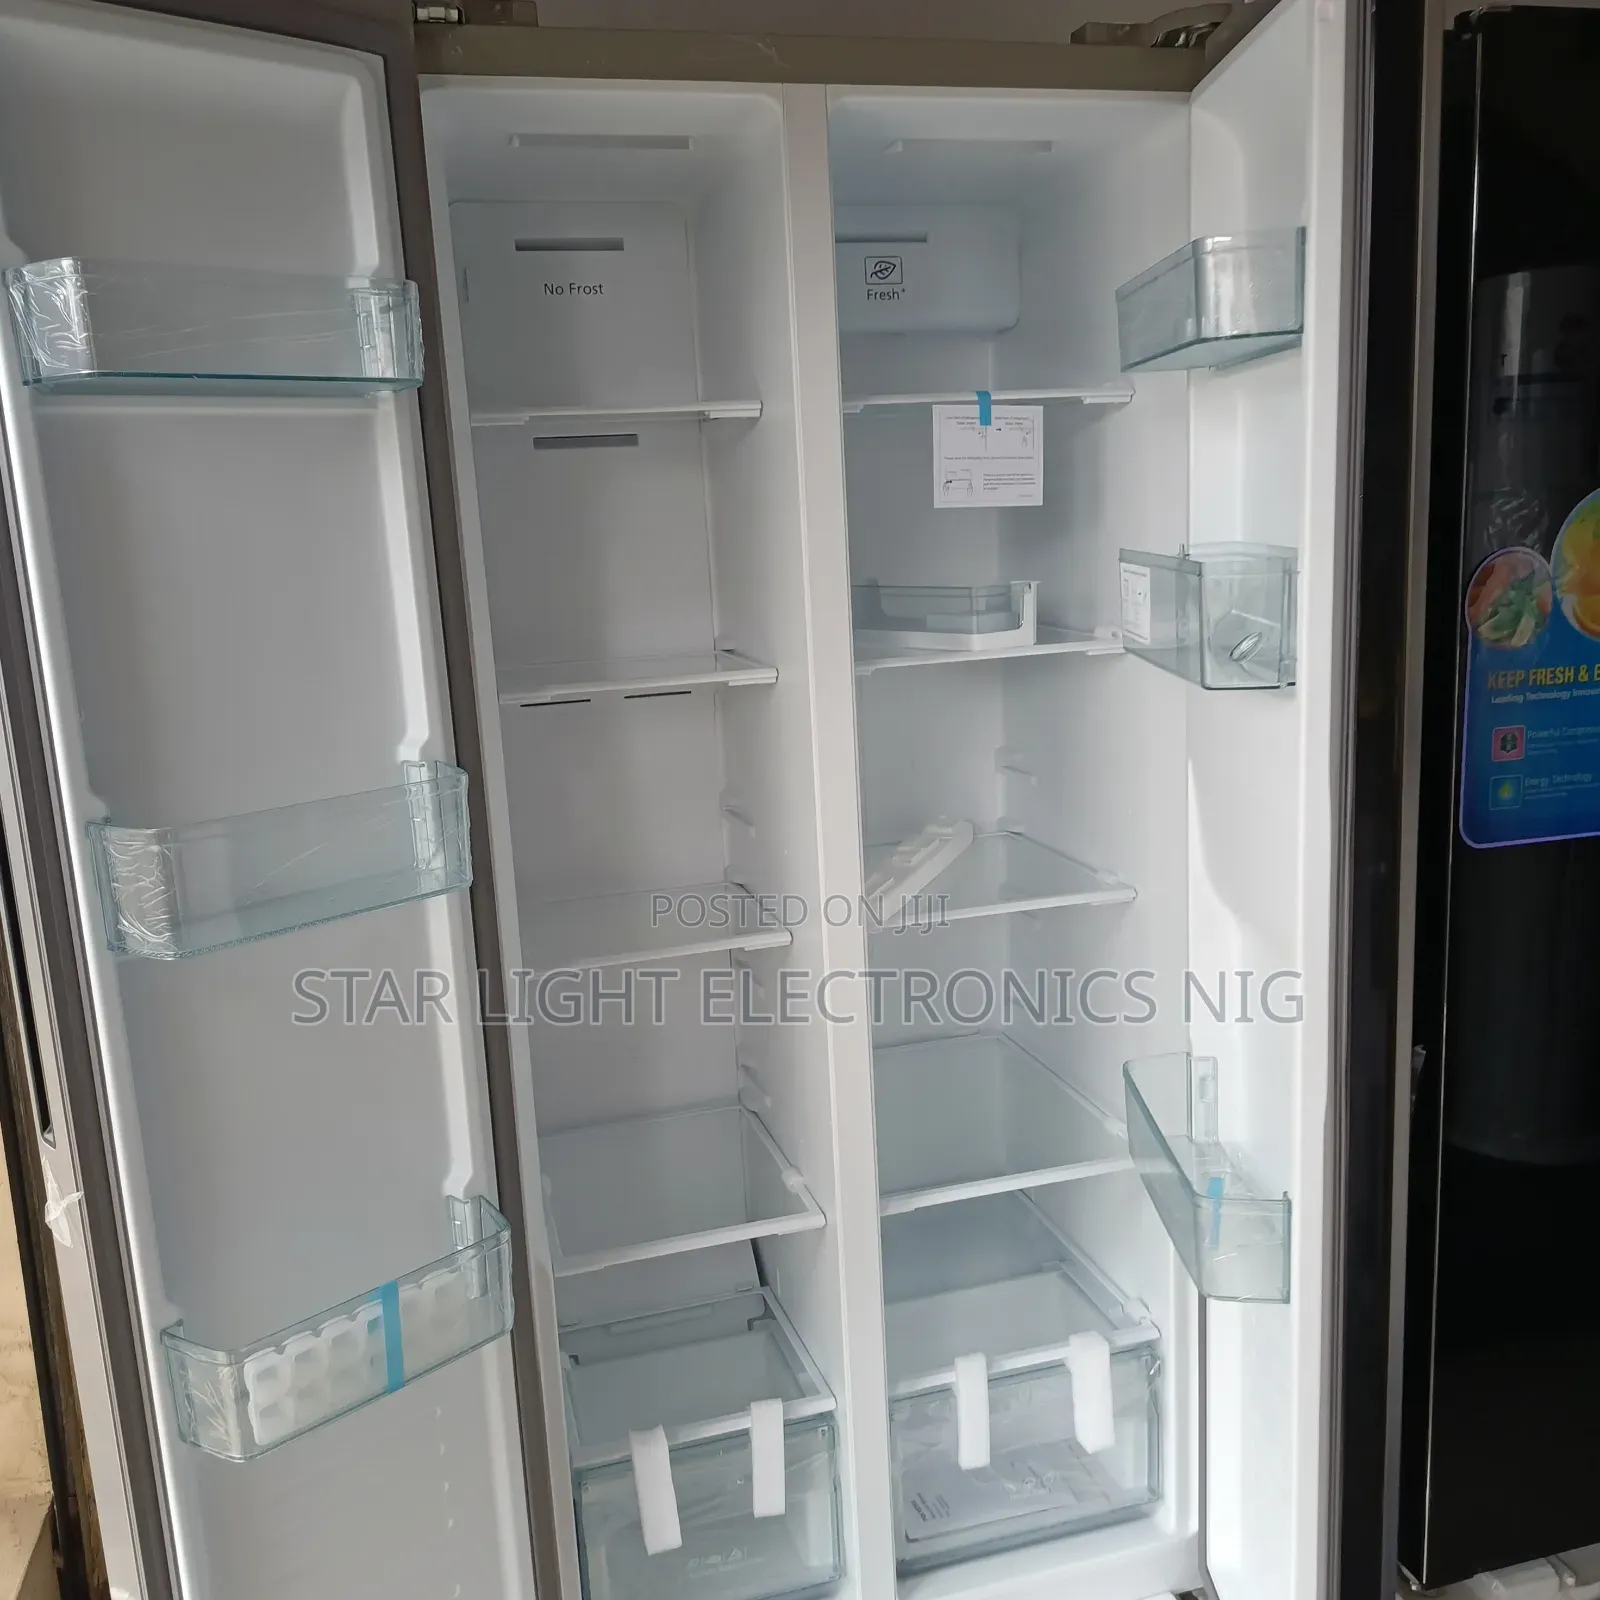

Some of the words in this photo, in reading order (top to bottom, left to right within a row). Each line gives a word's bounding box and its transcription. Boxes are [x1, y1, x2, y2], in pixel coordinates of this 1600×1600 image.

[543, 283, 564, 296] No
[569, 282, 604, 296] Frost
[1488, 669, 1525, 691] KEEP
[1528, 665, 1575, 686] FRESH
[1577, 664, 1589, 683] &
[1526, 688, 1572, 701] Technology
